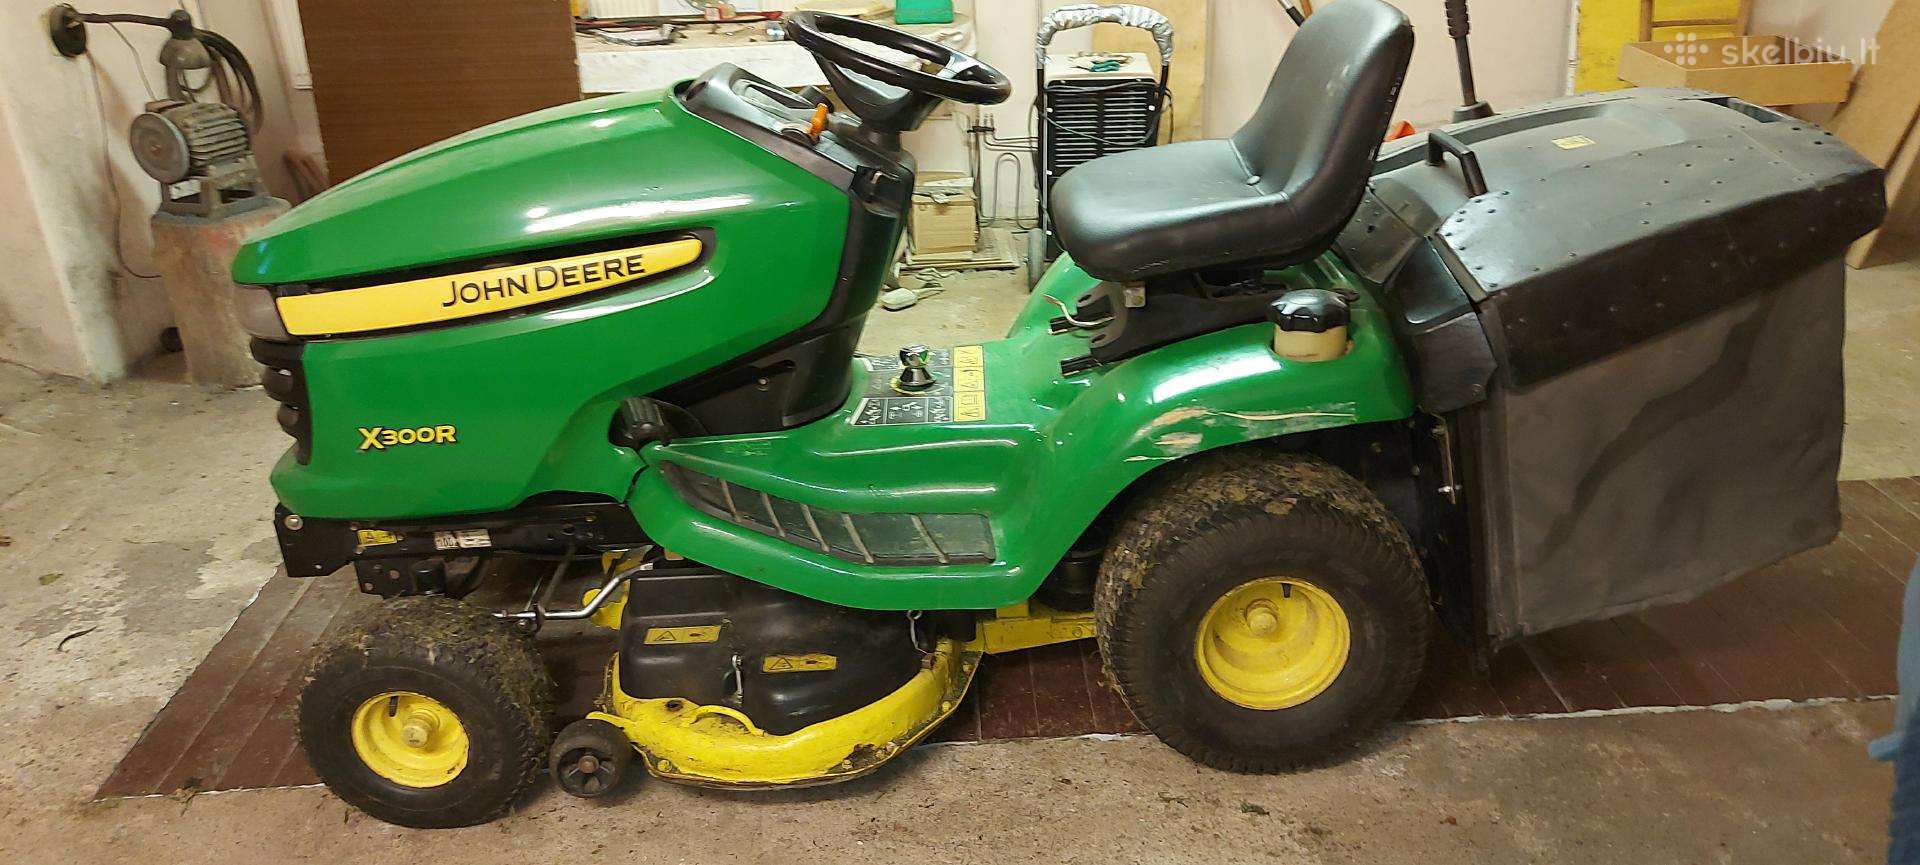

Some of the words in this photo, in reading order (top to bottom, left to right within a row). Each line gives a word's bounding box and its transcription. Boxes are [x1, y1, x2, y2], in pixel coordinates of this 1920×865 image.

[442, 275, 528, 307] JOHN
[535, 254, 646, 291] DEERE
[358, 425, 457, 449] X300R
